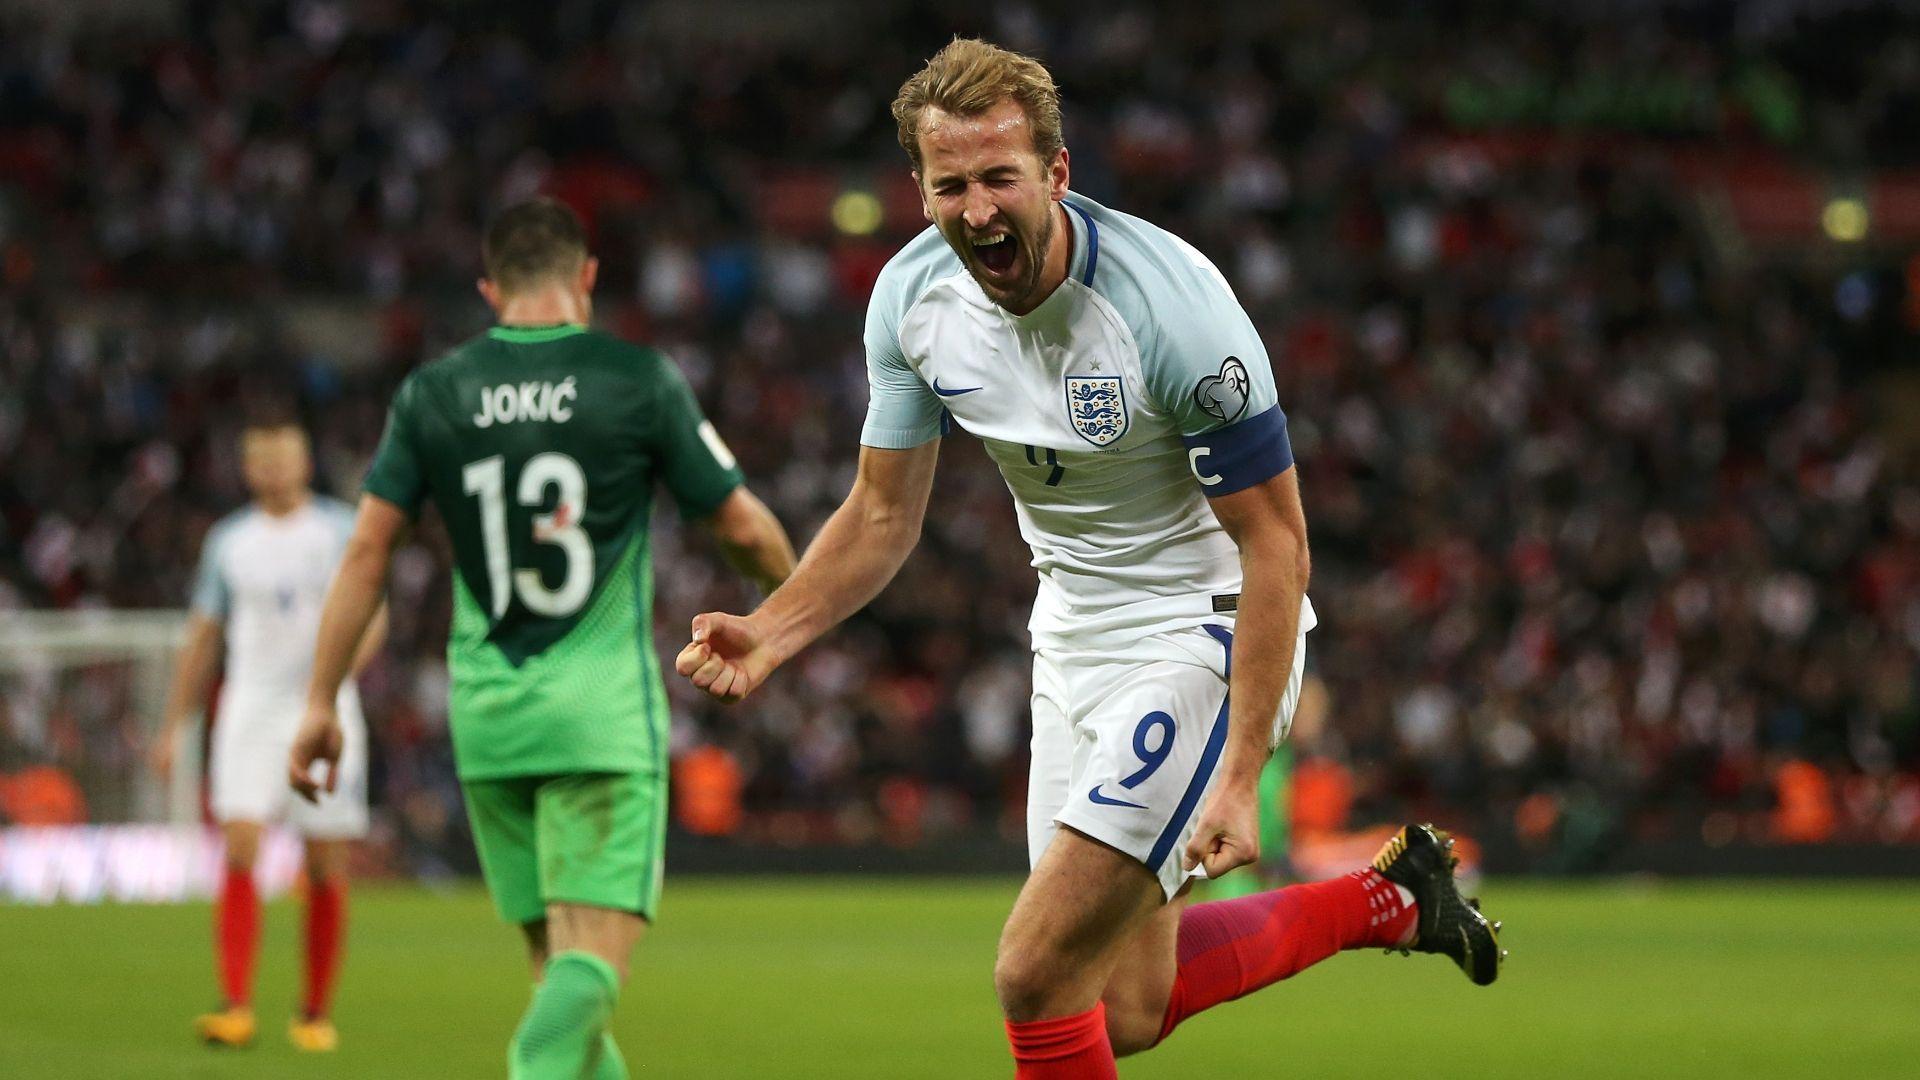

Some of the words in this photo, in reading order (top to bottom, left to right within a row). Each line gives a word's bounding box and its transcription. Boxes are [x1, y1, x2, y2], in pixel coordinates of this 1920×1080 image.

[474, 377, 577, 428] JOKIĆ
[1189, 447, 1223, 486] C
[462, 452, 595, 619] 13
[1119, 711, 1176, 790] 9
